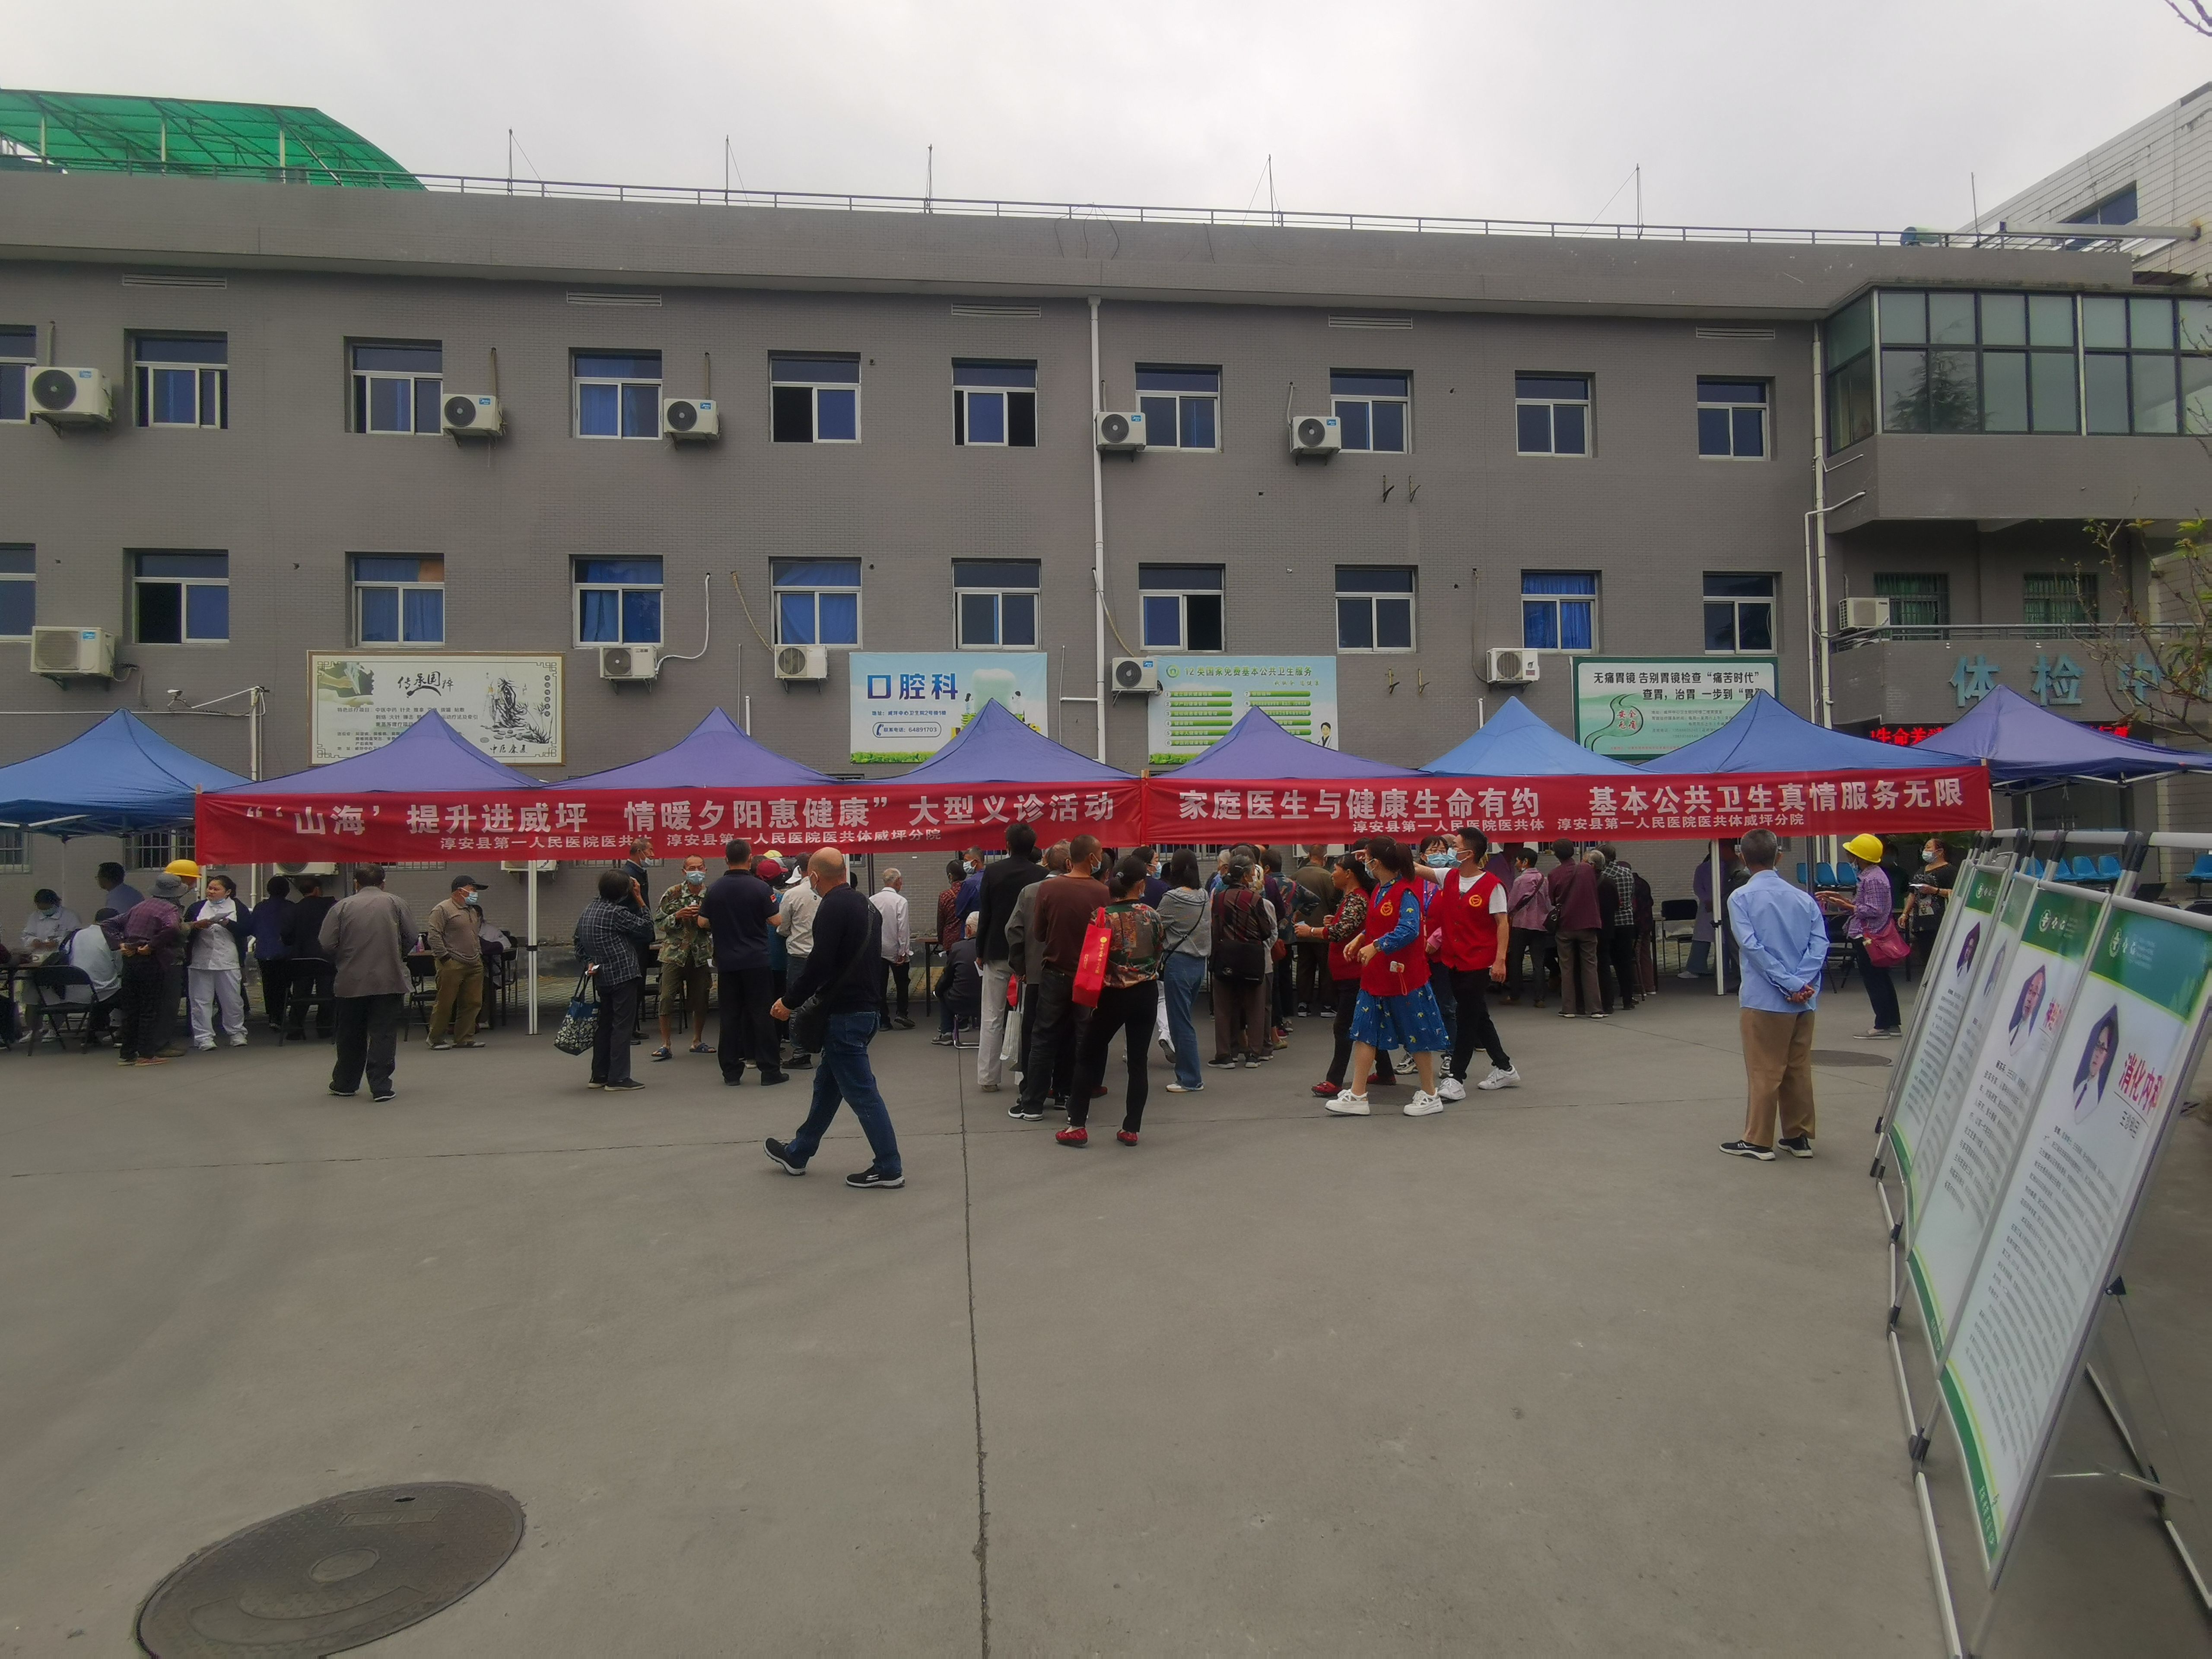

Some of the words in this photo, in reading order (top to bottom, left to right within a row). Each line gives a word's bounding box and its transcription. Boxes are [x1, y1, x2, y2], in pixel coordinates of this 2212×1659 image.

[867, 673, 958, 700] 口腔科
[1593, 672, 1636, 684] 无痛胃镜
[1949, 653, 2211, 707] 体检中
[1617, 709, 1637, 719] 安全
[1179, 787, 1539, 820] 家庭医生与健康生命有约
[1589, 778, 1964, 817] 基本公共卫生真情服务无限
[1557, 813, 1805, 831] 淳安县第一人民医院医共体威坪分院
[667, 829, 941, 847] 淳安县第一人民医院医共体威坪分院
